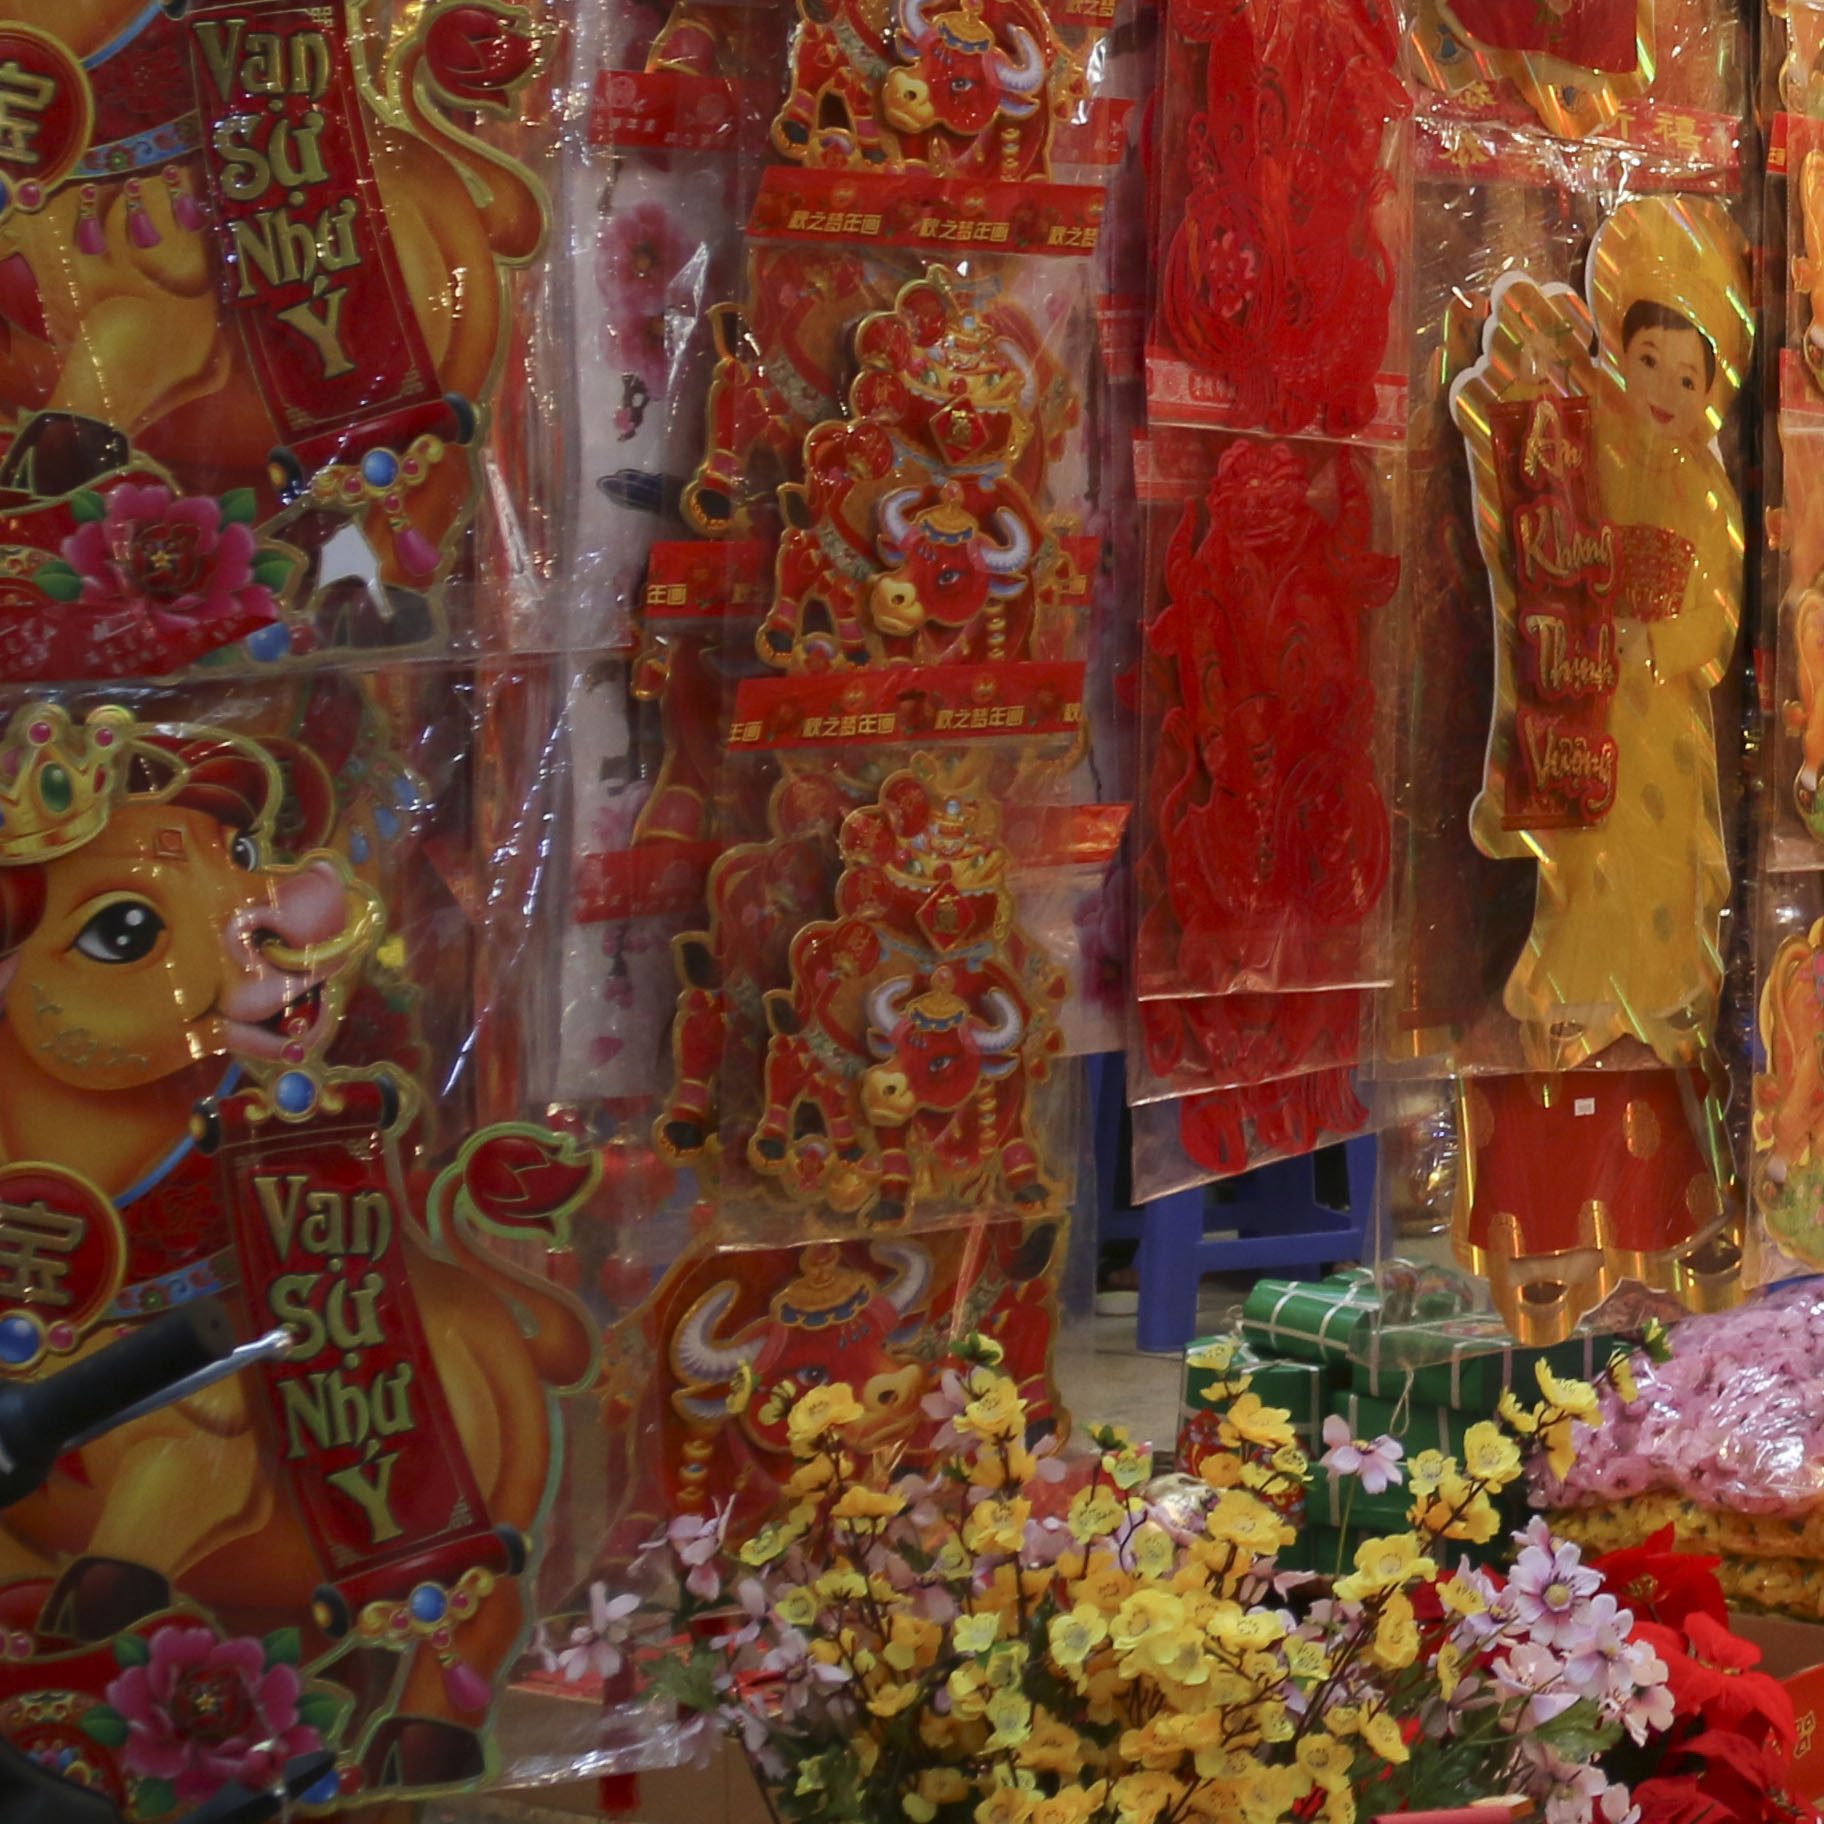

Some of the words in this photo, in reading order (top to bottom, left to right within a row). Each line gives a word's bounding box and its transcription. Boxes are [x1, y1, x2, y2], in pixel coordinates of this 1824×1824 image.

[194, 17, 331, 111] Vạn
[213, 108, 327, 208] Sự
[230, 197, 362, 299] Như
[279, 274, 356, 379] Ý
[1524, 400, 1583, 477] An
[1519, 504, 1616, 594] Khang
[253, 1176, 392, 1273] Vạn
[267, 1269, 386, 1370] Sự
[278, 1359, 416, 1461] Như
[328, 1437, 404, 1544] Ý
